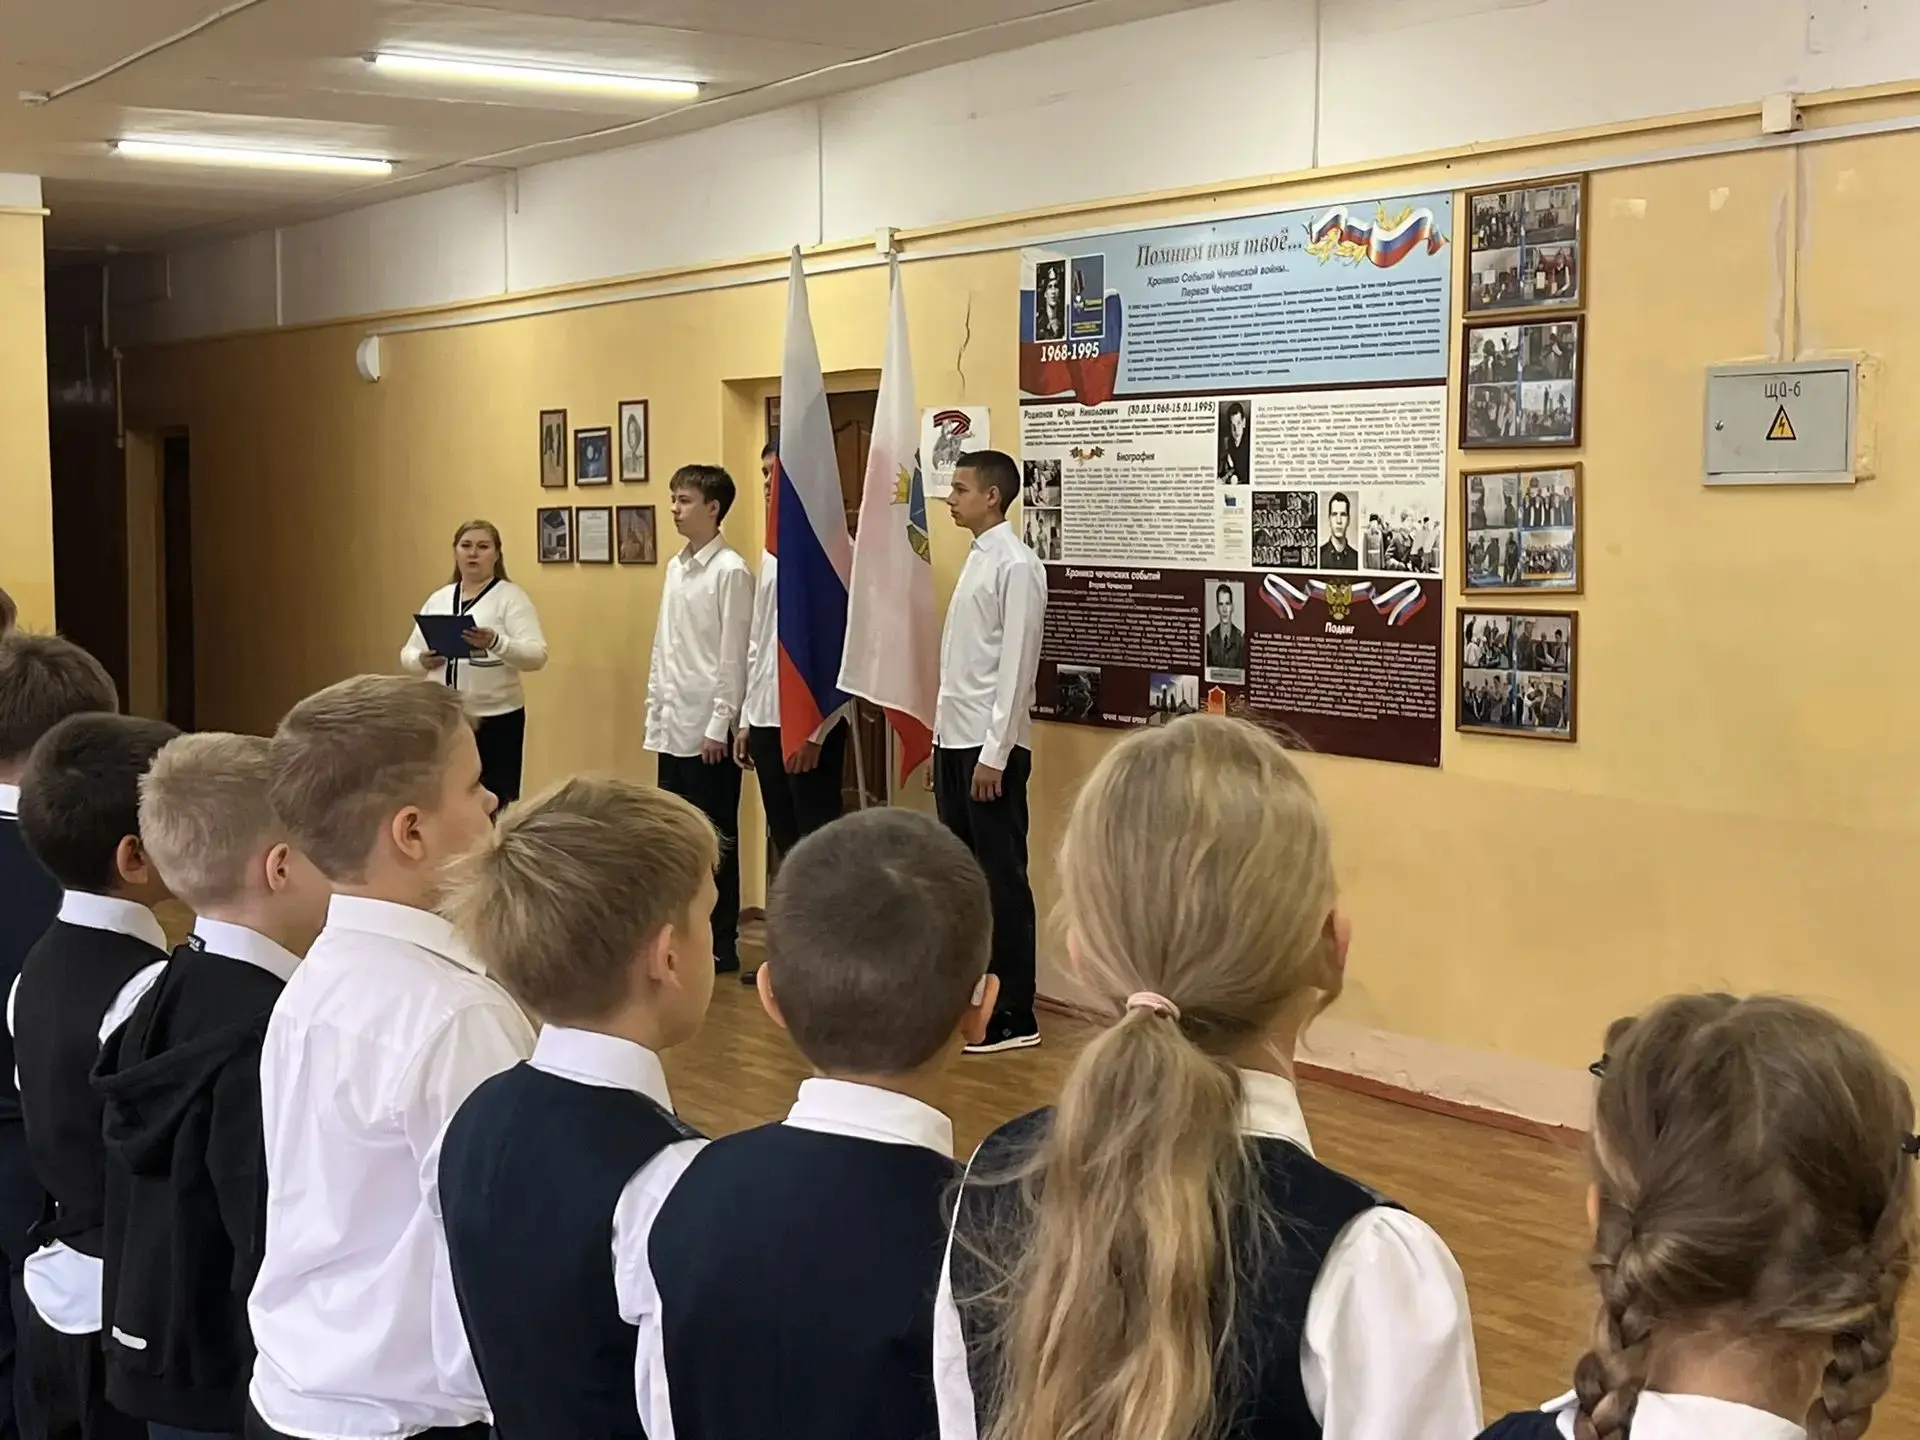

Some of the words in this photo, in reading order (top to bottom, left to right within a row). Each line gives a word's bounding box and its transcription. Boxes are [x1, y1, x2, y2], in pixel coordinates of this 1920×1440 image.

[1136, 242, 1203, 268] Помним
[1207, 240, 1240, 260] имя
[1244, 227, 1302, 255] твоё...
[1147, 275, 1180, 288] Хроника
[1181, 270, 1215, 283] Событий
[1217, 265, 1259, 279] Чеченской
[1181, 286, 1209, 298] Первая
[1211, 282, 1253, 294] Чеченская
[1040, 341, 1100, 362] 1968-1995
[1024, 410, 1053, 420] Родионов
[1057, 407, 1075, 418] Юрий
[1079, 407, 1119, 417] Николаевич
[1116, 451, 1155, 462] Биография
[1065, 567, 1094, 579] Хроника
[1095, 570, 1131, 580] чеченских
[1131, 570, 1162, 580] событий
[1088, 581, 1106, 589] Вторая
[1107, 581, 1133, 590] Чеченская
[1325, 621, 1355, 635] Подвиг
